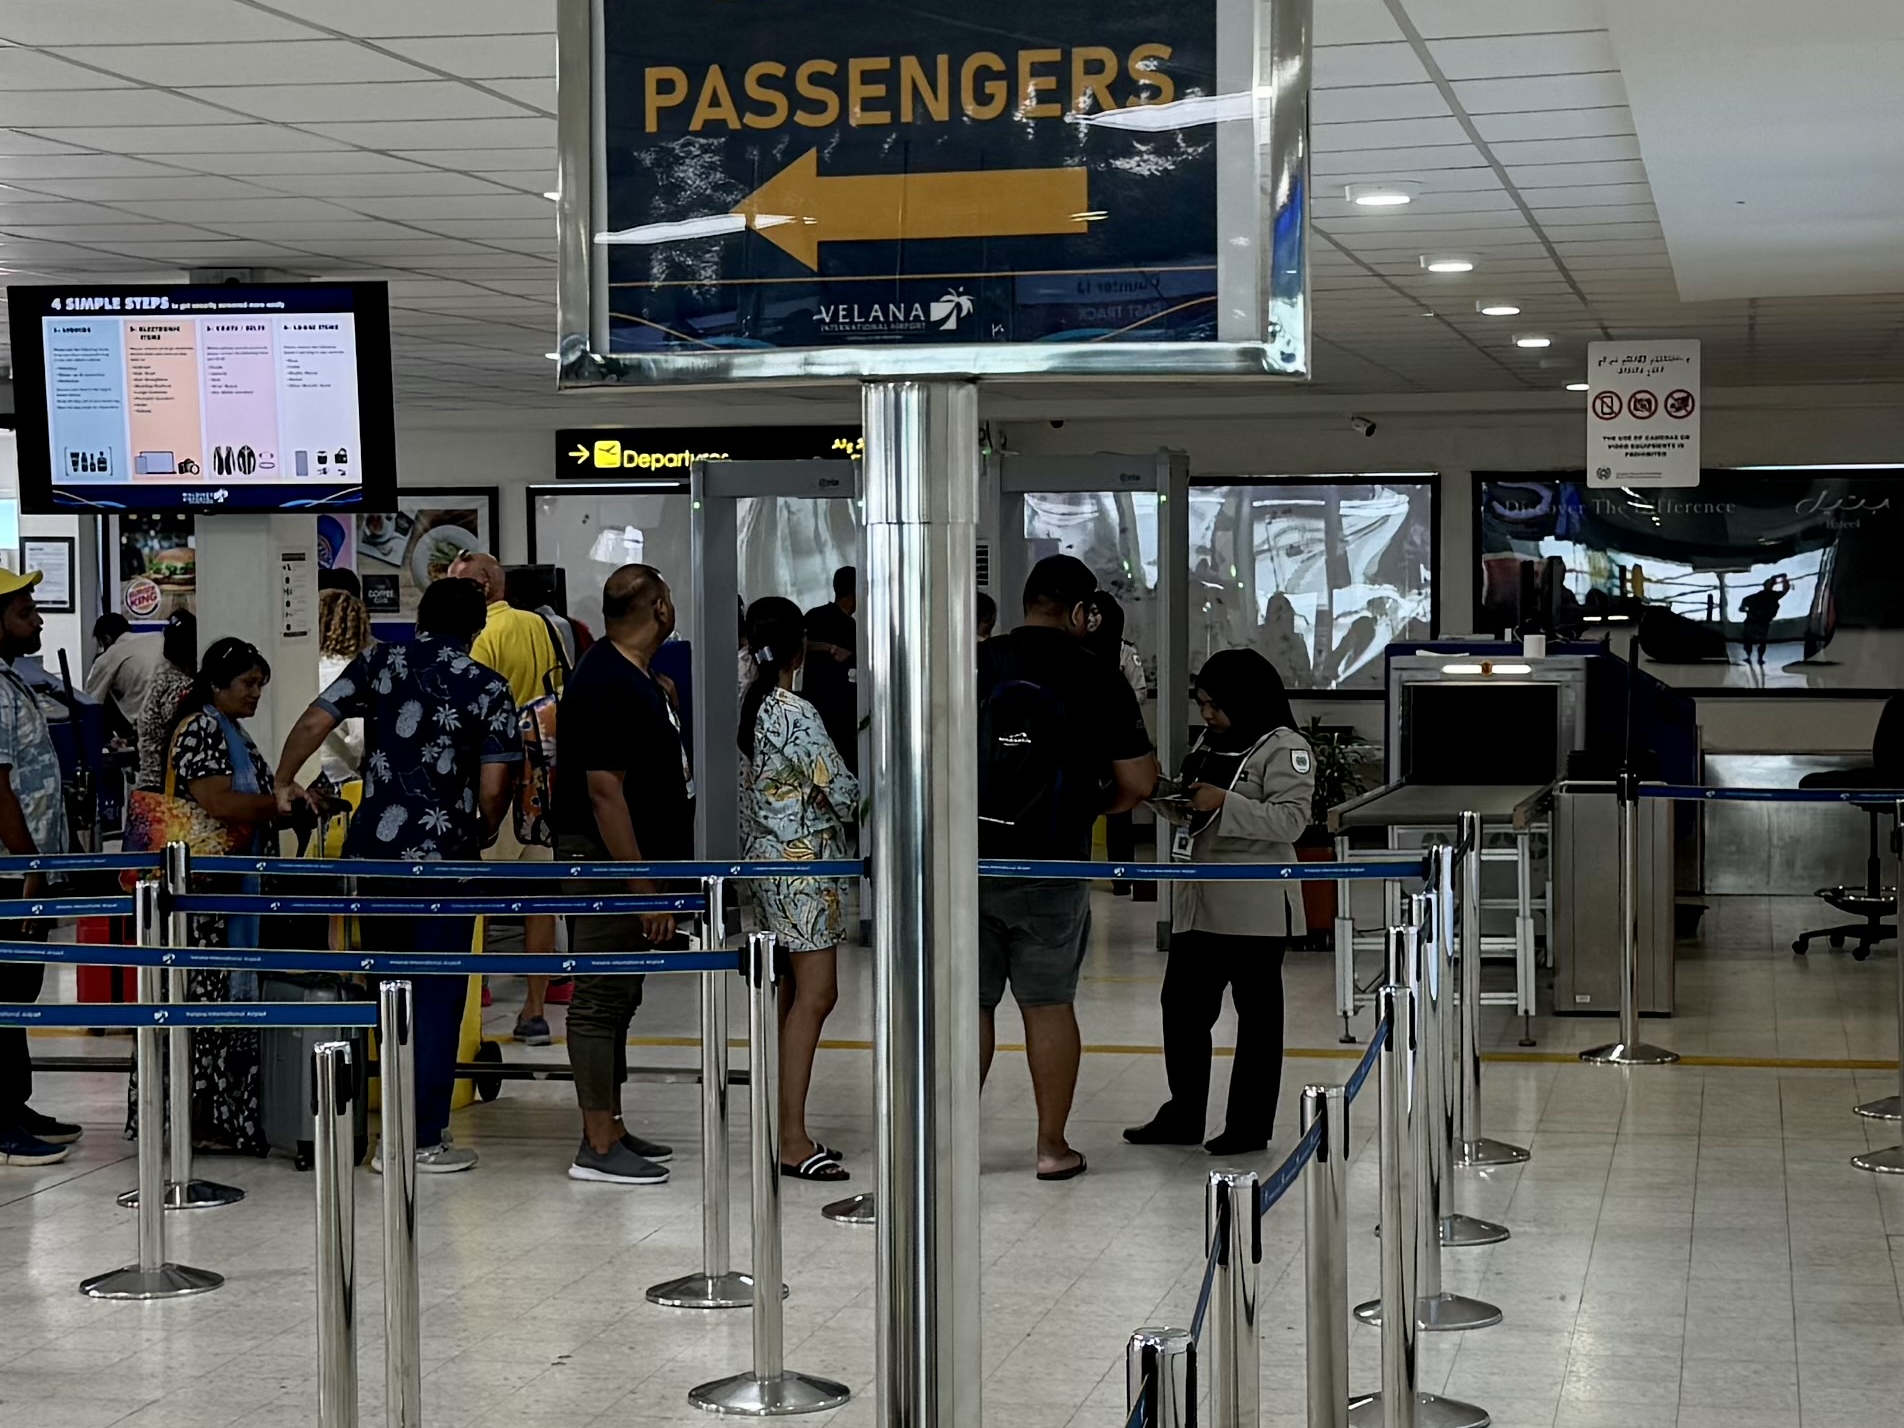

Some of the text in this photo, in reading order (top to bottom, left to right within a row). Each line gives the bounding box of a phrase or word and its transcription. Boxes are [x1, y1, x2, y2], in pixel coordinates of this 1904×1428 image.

[645, 43, 1175, 132] PASSENGERS
[50, 296, 62, 310] 4
[65, 296, 121, 310] SIMPLE
[124, 295, 170, 310] STEPS
[820, 302, 925, 324] VELANA
[1591, 498, 1627, 515] The
